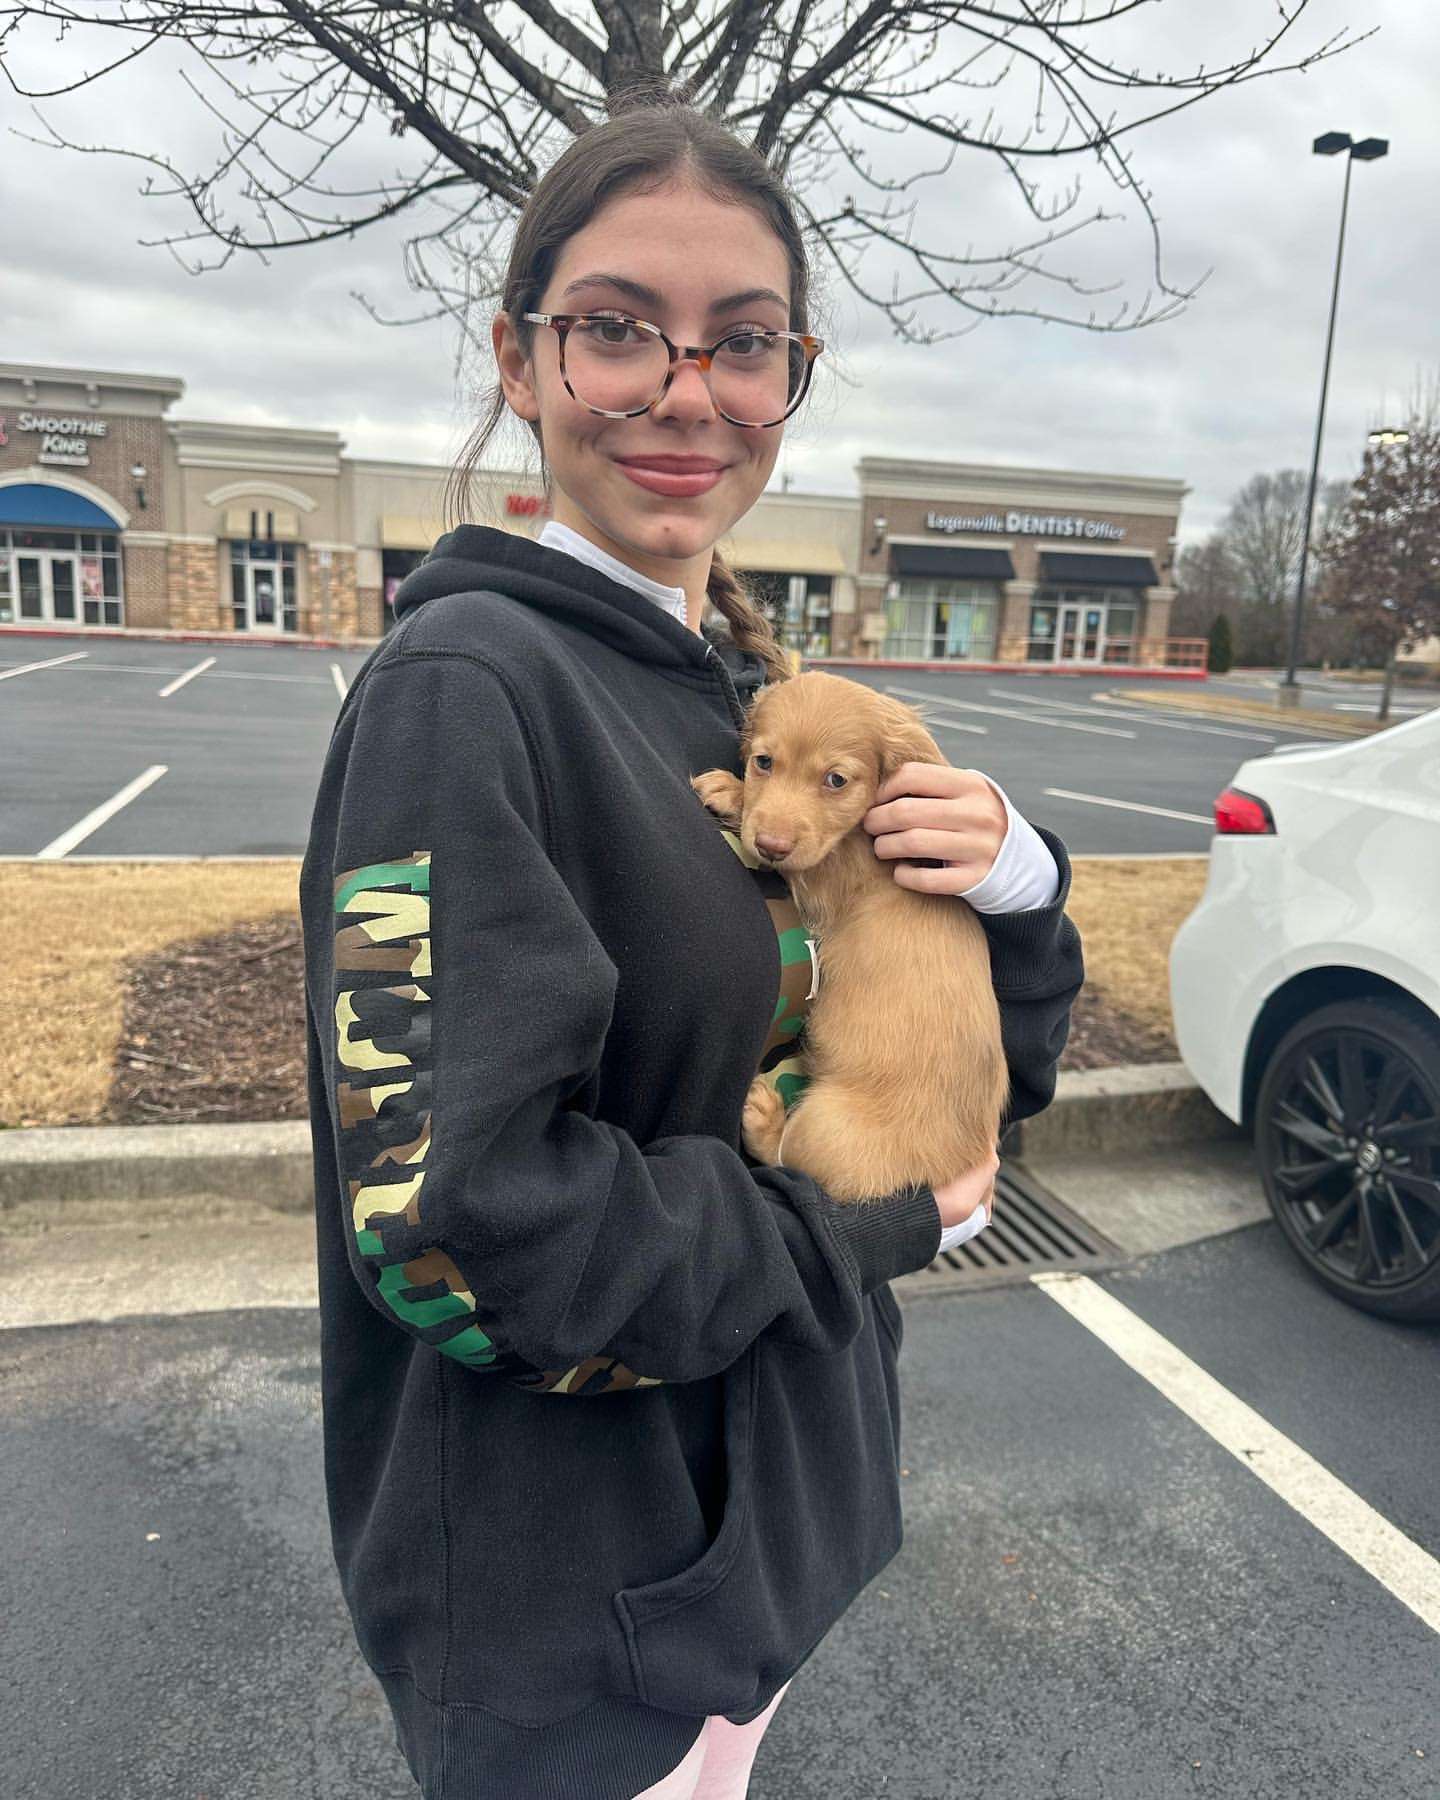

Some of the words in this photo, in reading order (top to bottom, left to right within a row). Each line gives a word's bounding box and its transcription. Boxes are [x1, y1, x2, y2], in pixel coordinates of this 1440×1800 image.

[17, 412, 107, 436] SMOOTHIE
[42, 434, 89, 455] KING
[1005, 511, 1085, 537] DENTIST
